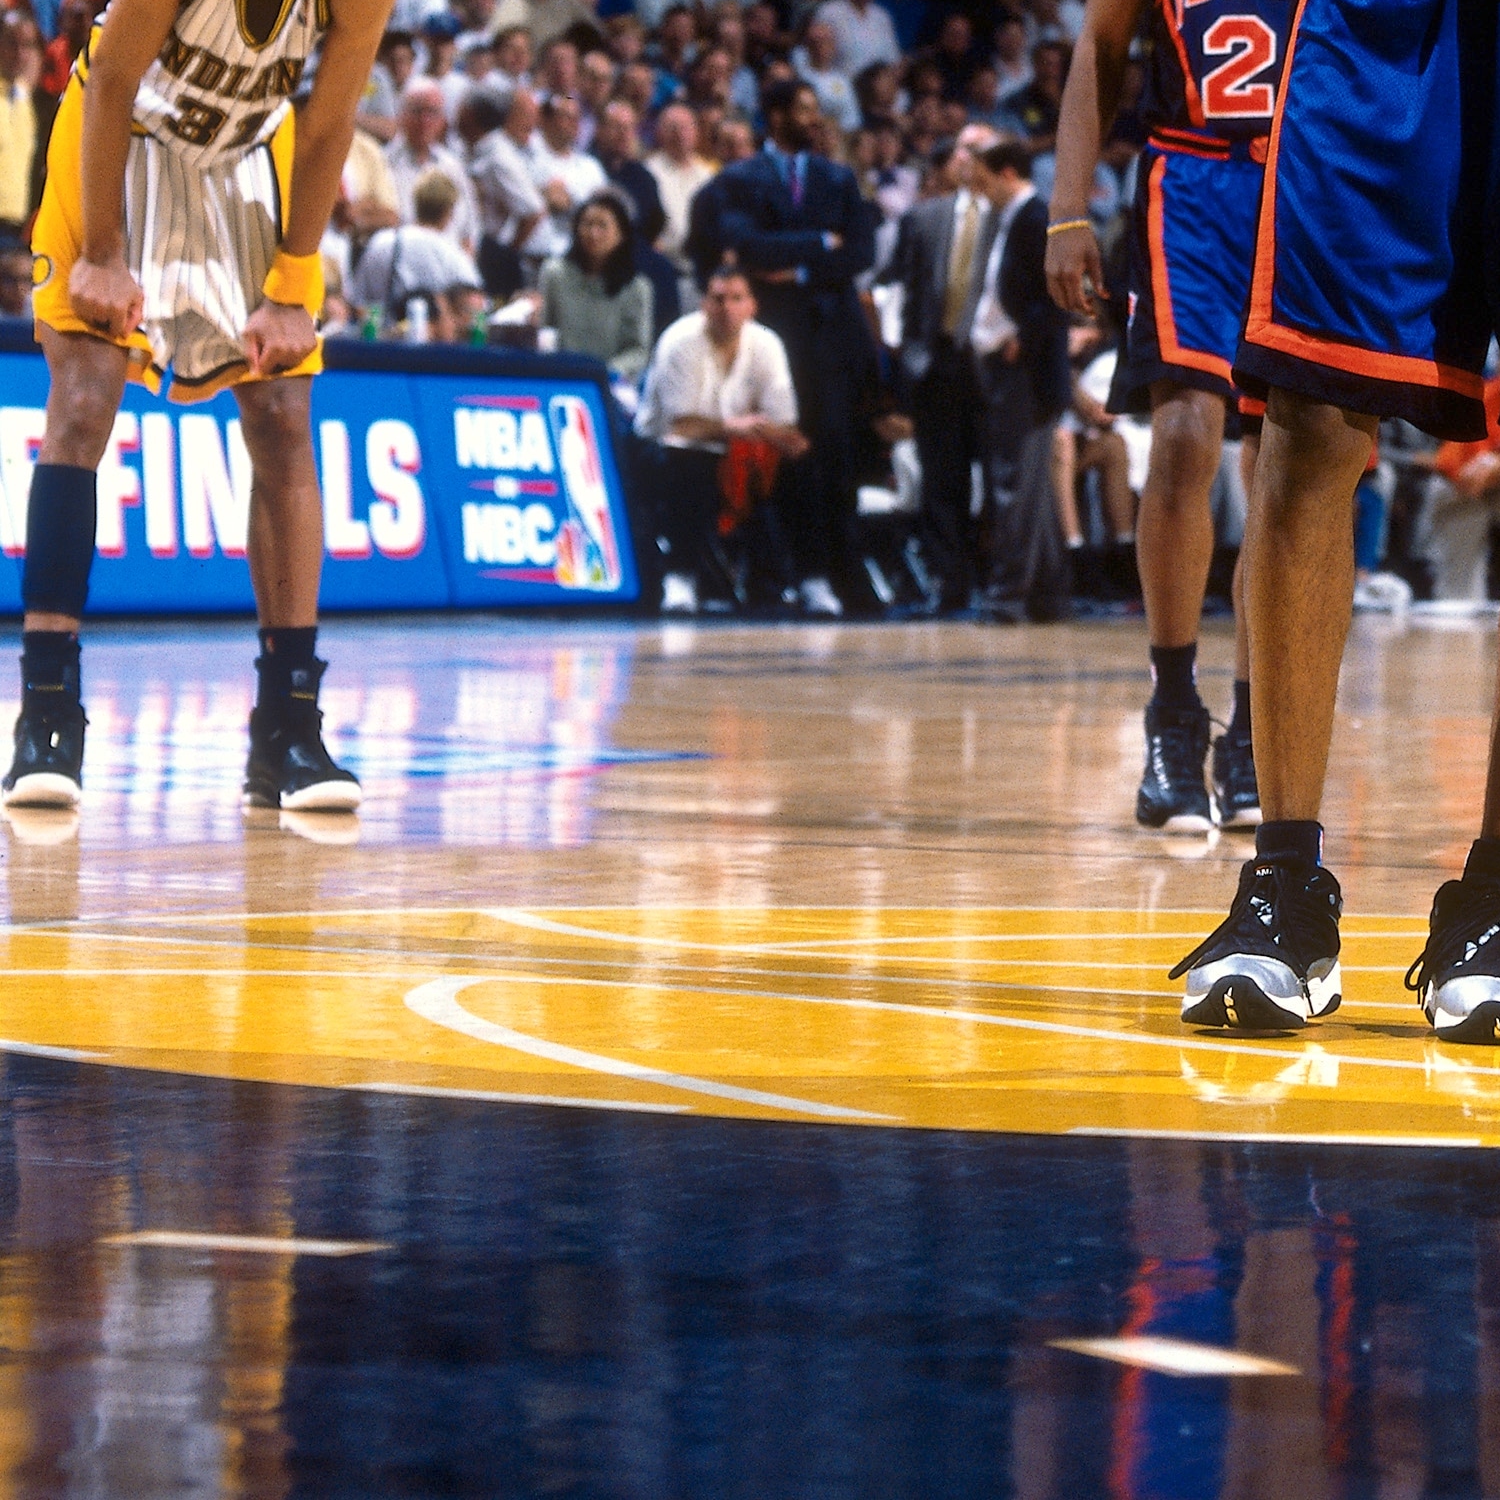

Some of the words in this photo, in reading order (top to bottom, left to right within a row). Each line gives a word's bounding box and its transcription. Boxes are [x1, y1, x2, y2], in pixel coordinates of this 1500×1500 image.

[160, 38, 305, 101] NDIAN
[1202, 14, 1277, 119] 2
[454, 407, 554, 474] NBA
[95, 410, 426, 559] FINLS
[461, 501, 558, 567] NBC
